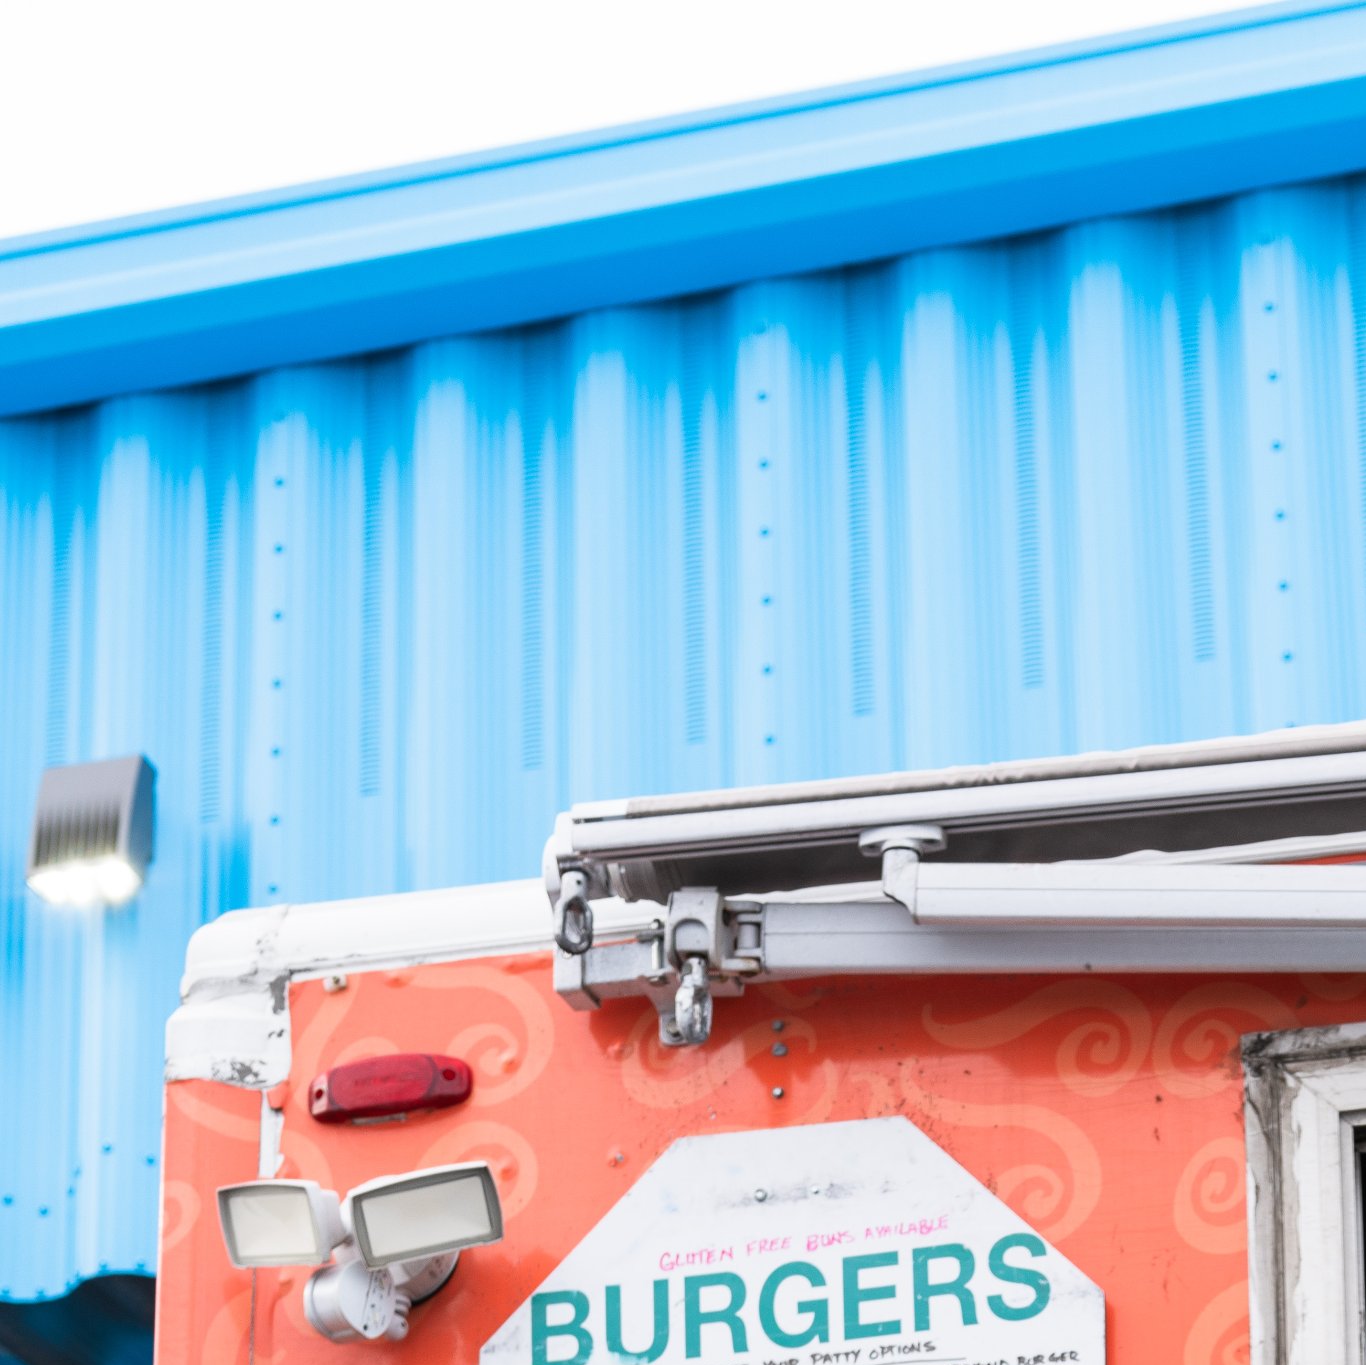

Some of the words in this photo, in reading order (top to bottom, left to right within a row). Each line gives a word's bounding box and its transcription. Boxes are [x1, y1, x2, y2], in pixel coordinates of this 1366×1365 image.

[659, 1247, 734, 1271] GLUTEN
[746, 1236, 792, 1256] FREE
[806, 1230, 855, 1251] BUNS
[865, 1214, 950, 1240] AVAILABLE
[869, 1341, 936, 1360] OPTIONS
